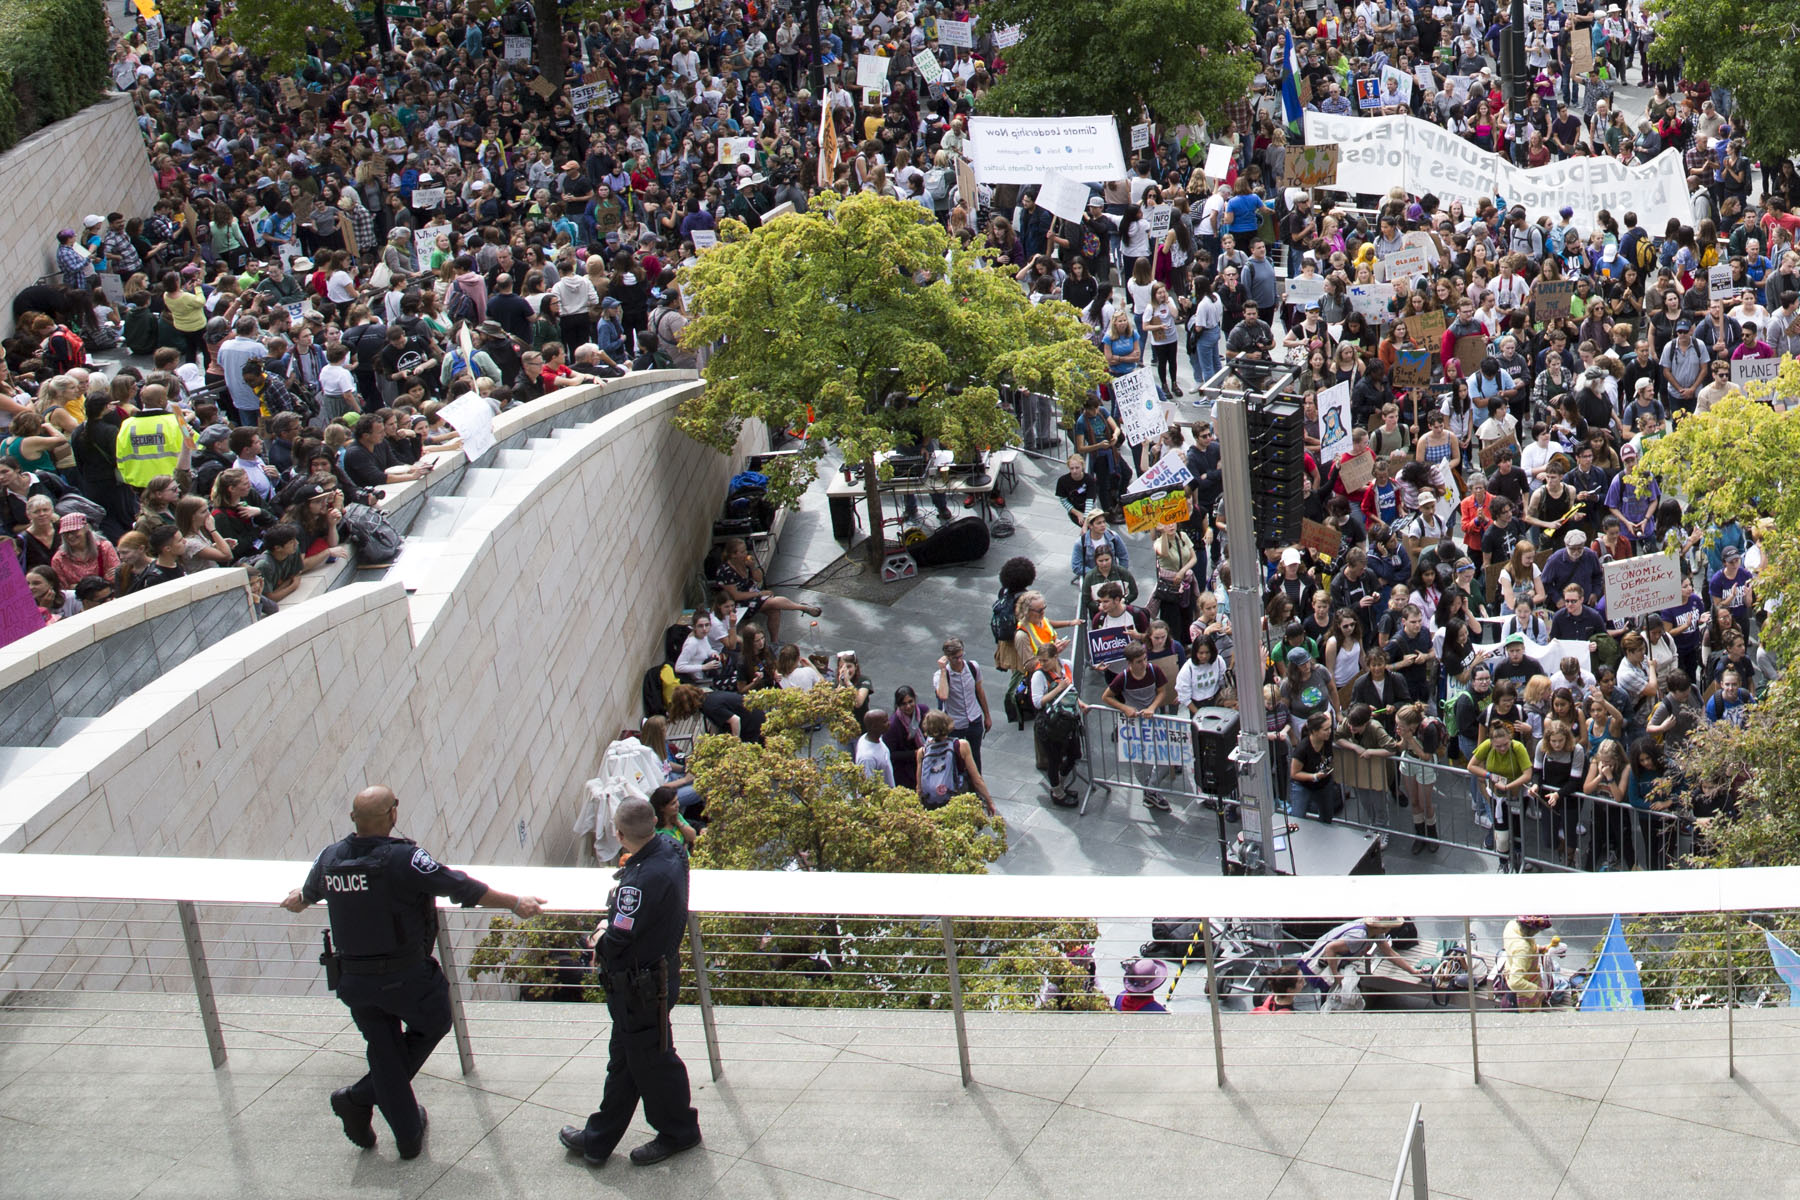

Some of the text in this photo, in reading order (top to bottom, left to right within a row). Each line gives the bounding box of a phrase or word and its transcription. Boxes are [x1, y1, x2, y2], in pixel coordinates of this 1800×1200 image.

[1287, 175, 1334, 187] TO ACT
[1153, 214, 1170, 223] INFO
[416, 230, 441, 240] Which
[1538, 281, 1574, 294] UNITE
[1546, 300, 1559, 309] THE
[1395, 366, 1417, 377] Stop!
[1739, 363, 1780, 379] PLANET
[1114, 375, 1139, 390] FIGHT
[1116, 382, 1145, 399] CLIMATE
[1118, 397, 1140, 407] CHANGE
[1127, 422, 1140, 433] DIE
[130, 432, 165, 447] SECURITY
[1131, 426, 1161, 445] FRYING
[1164, 509, 1187, 523] EARTH
[1607, 563, 1662, 586] ECONOMIC
[1613, 590, 1661, 611] SOCIALIST
[1629, 593, 1676, 613] REVOLUTION
[1091, 635, 1128, 654] Morales
[1120, 717, 1135, 727] THE
[1119, 726, 1167, 744] CLEAN
[1170, 735, 1189, 744] NOT
[1123, 743, 1193, 764] URANUS
[325, 874, 369, 892] POLICE
